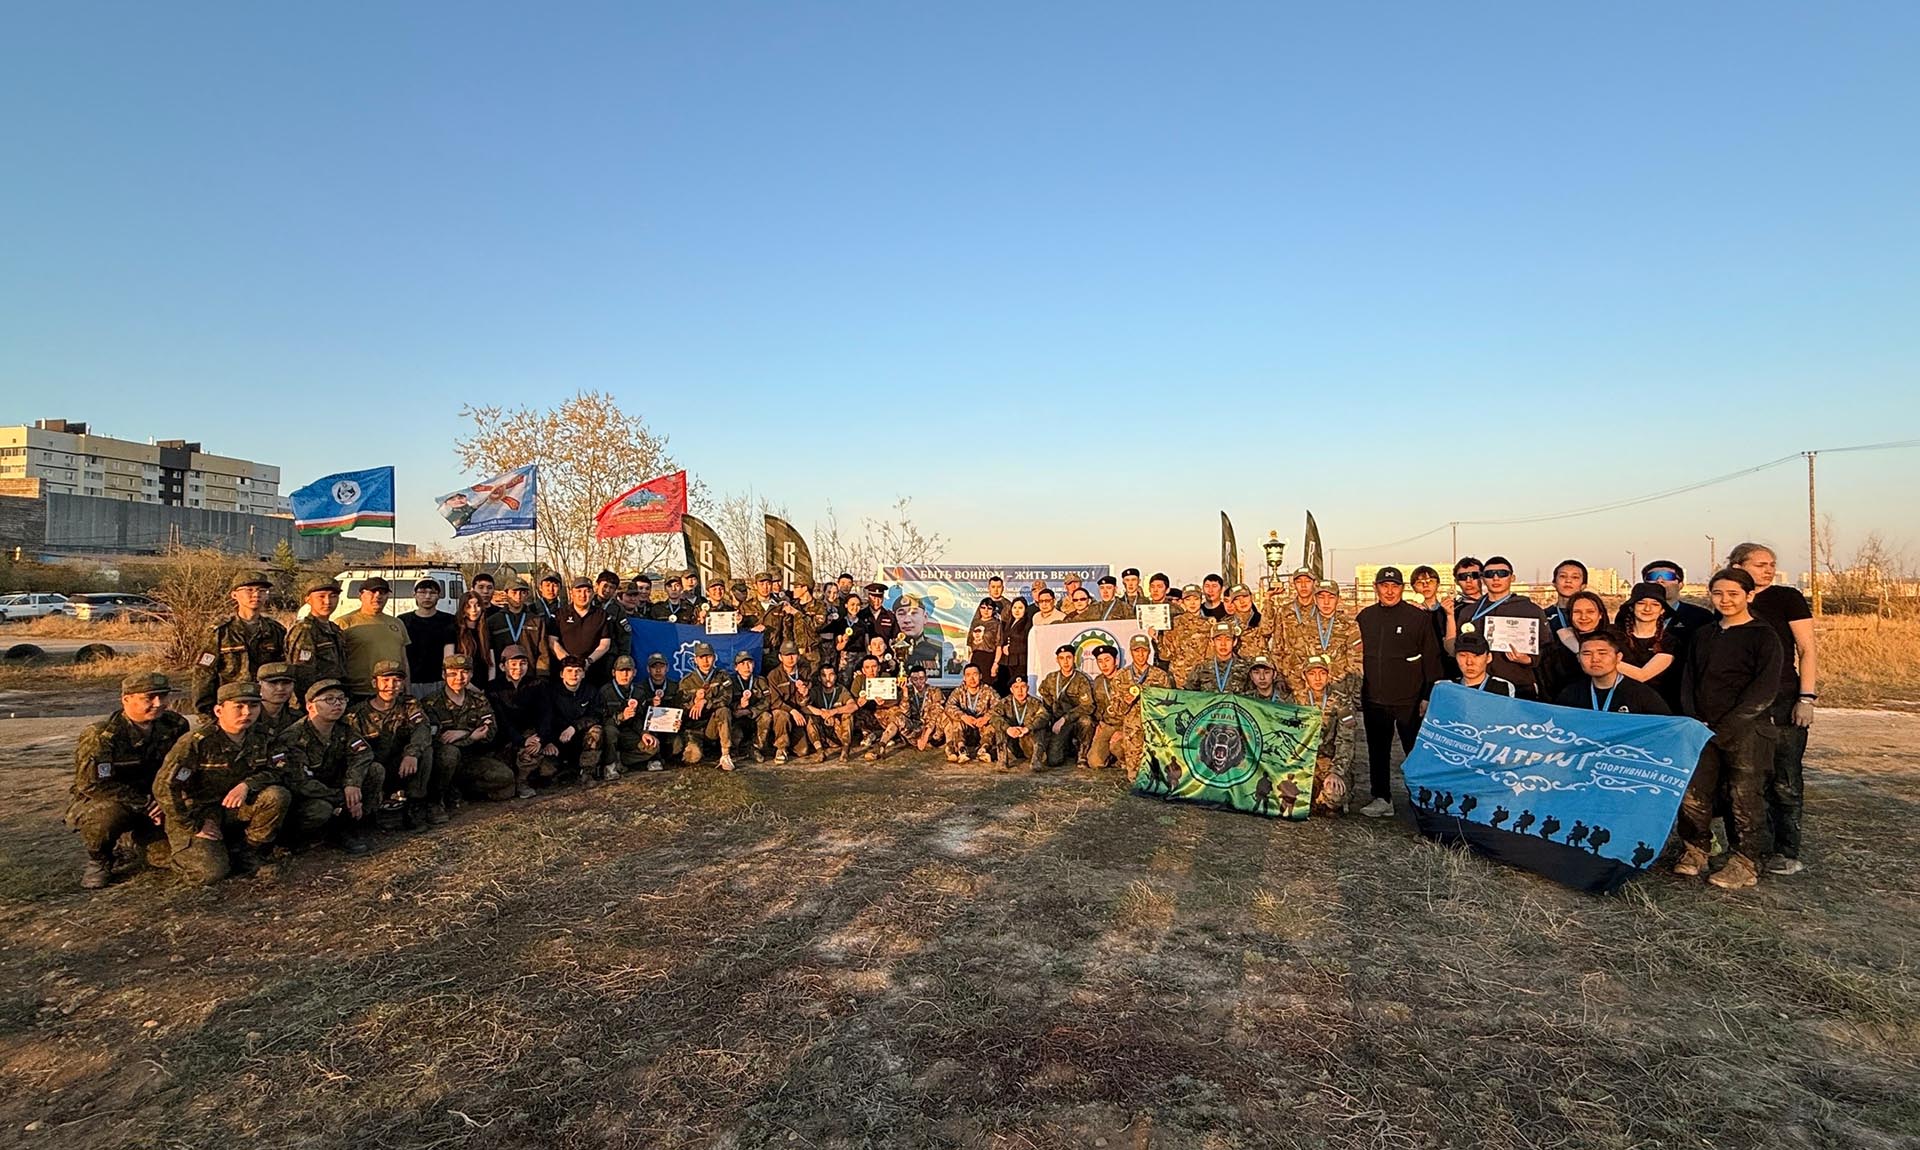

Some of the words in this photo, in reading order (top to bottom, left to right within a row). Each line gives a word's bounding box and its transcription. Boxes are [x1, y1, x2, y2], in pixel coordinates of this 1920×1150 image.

[920, 570, 953, 579] БЫТЬ
[1015, 570, 1049, 580] ЖИТЬ
[1050, 570, 1090, 580] ВЕО
[1594, 761, 1658, 781] СПОРТИВНЫЙ
[1658, 773, 1687, 789] КЛУБ
